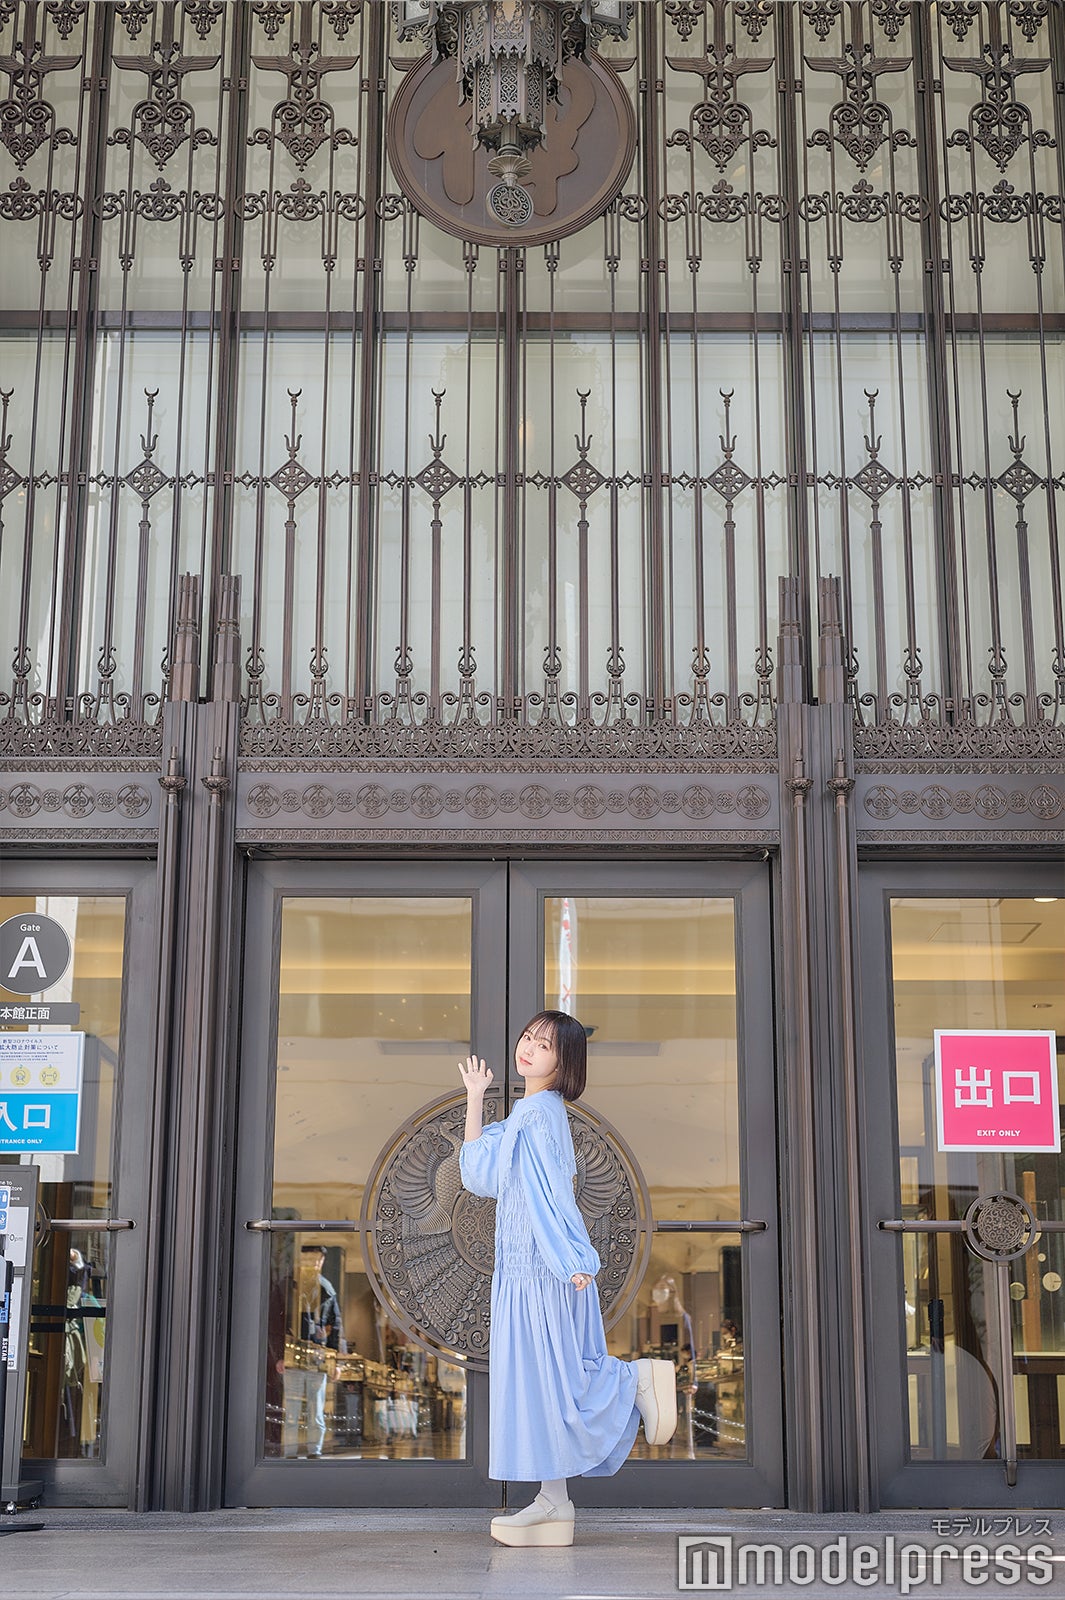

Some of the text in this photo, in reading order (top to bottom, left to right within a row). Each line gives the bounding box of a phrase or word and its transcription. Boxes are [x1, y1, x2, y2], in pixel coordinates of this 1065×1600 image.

[20, 923, 41, 932] Gate
[8, 936, 47, 978] A
[0, 1006, 51, 1020] 本館正面
[955, 1066, 1041, 1108] 出口
